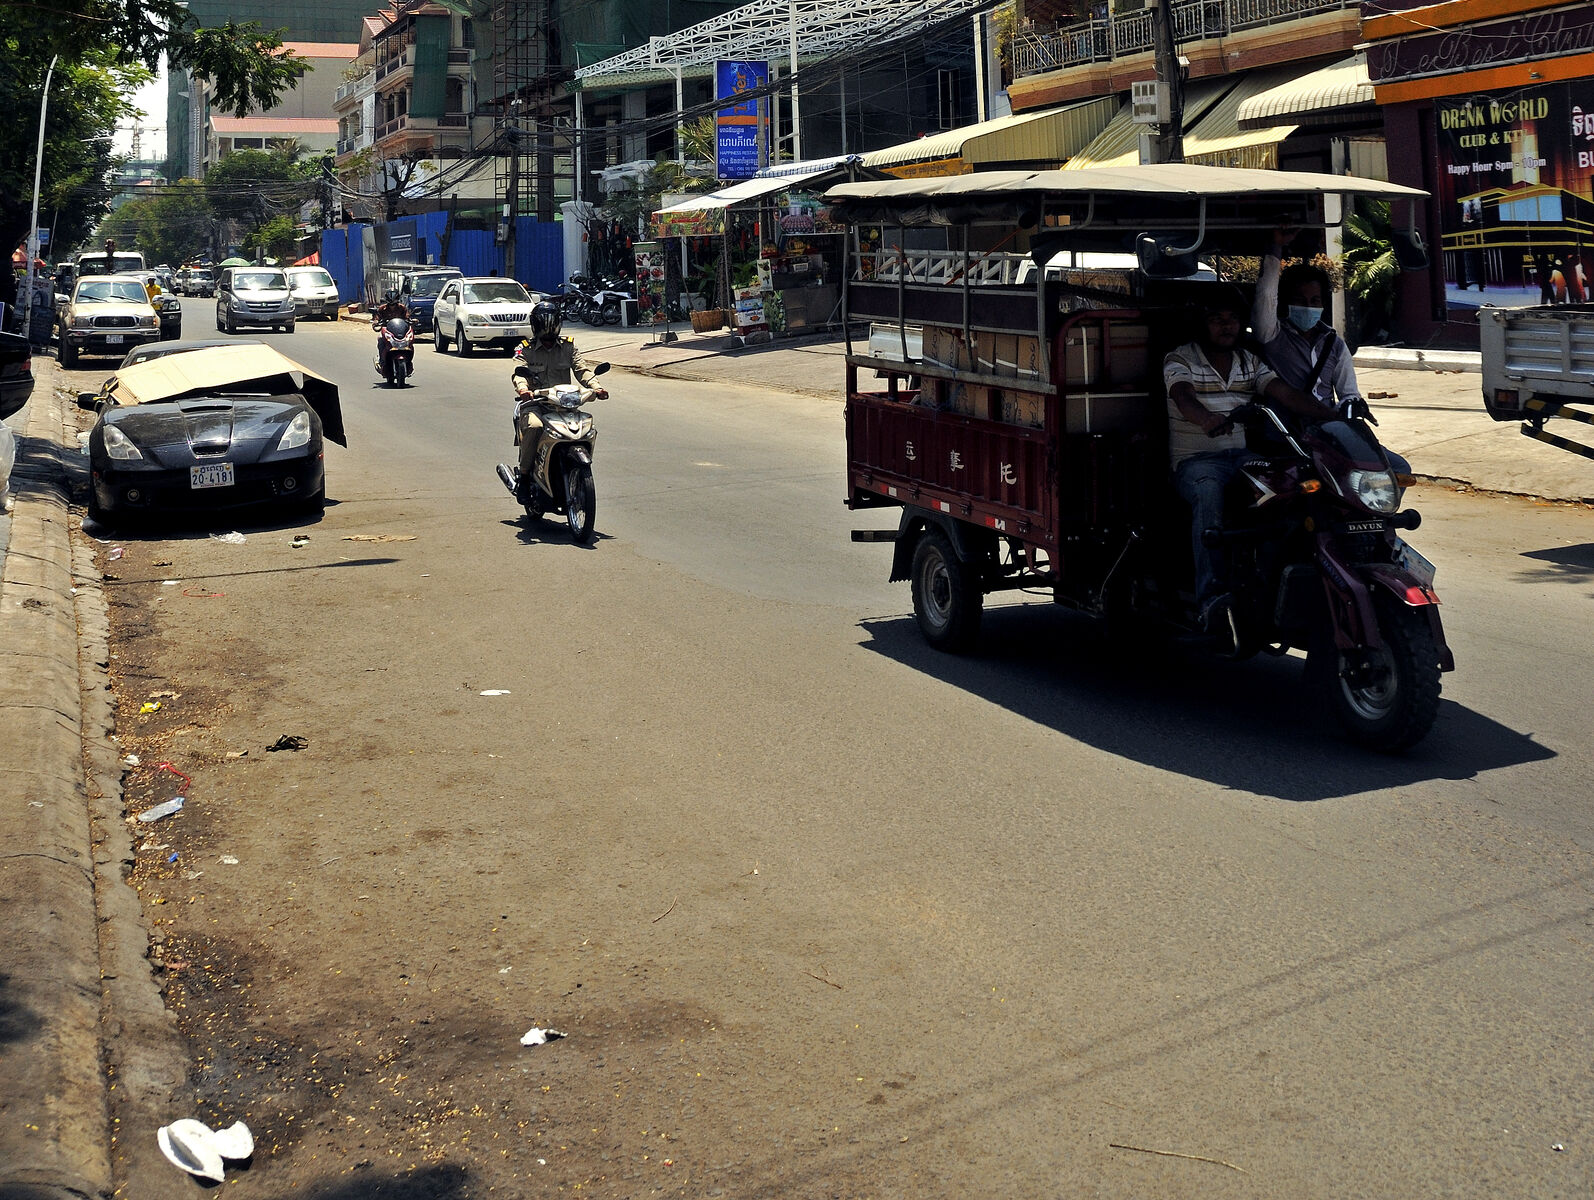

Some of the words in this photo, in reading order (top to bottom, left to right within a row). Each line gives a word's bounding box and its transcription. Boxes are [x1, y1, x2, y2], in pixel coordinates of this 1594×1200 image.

[1459, 133, 1487, 149] CLUB
[1489, 132, 1501, 146] &
[1447, 162, 1471, 176] Happy
[1472, 161, 1493, 173] Hour
[1495, 159, 1514, 173] 8pm
[1349, 522, 1383, 532] DAYUN
